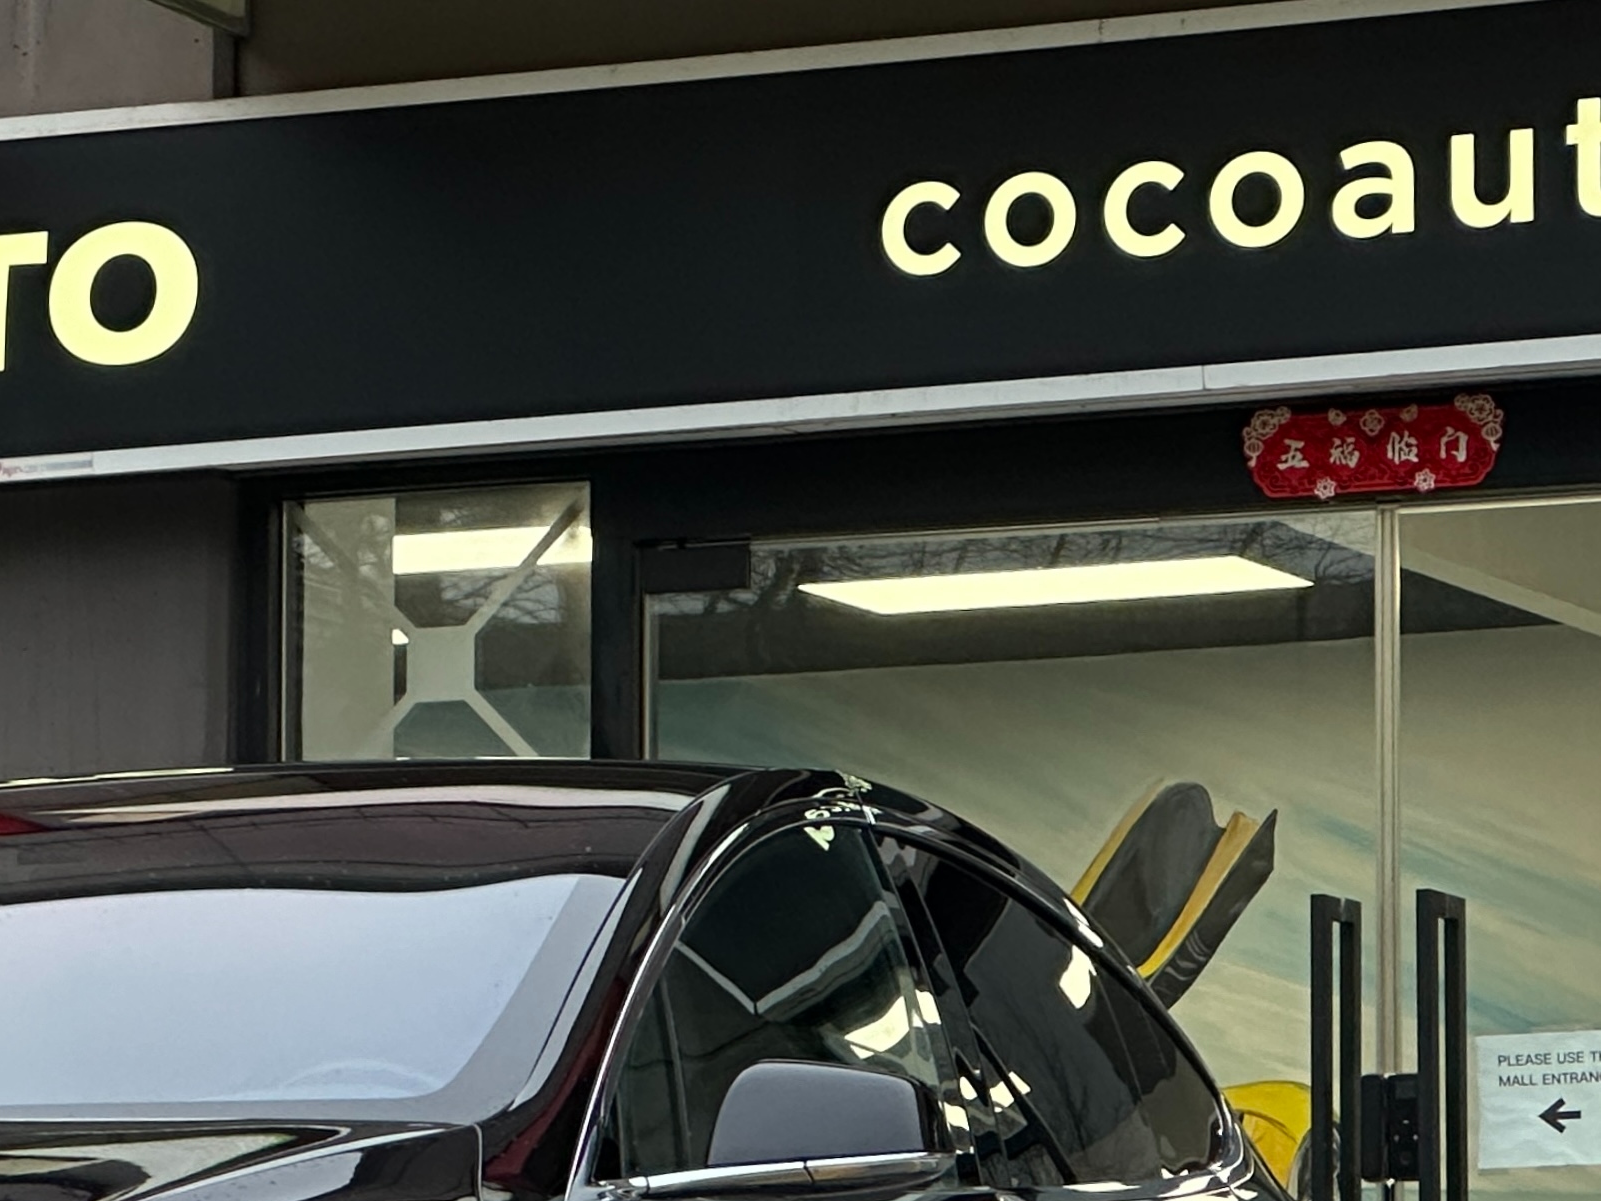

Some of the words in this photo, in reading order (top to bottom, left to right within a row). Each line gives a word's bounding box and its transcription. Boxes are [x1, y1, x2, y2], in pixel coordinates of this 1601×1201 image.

[1276, 426, 1468, 470] 五福临门
[1498, 1053, 1552, 1067] PLEASE
[1557, 1051, 1584, 1064] USE
[1499, 1074, 1538, 1087] MALL
